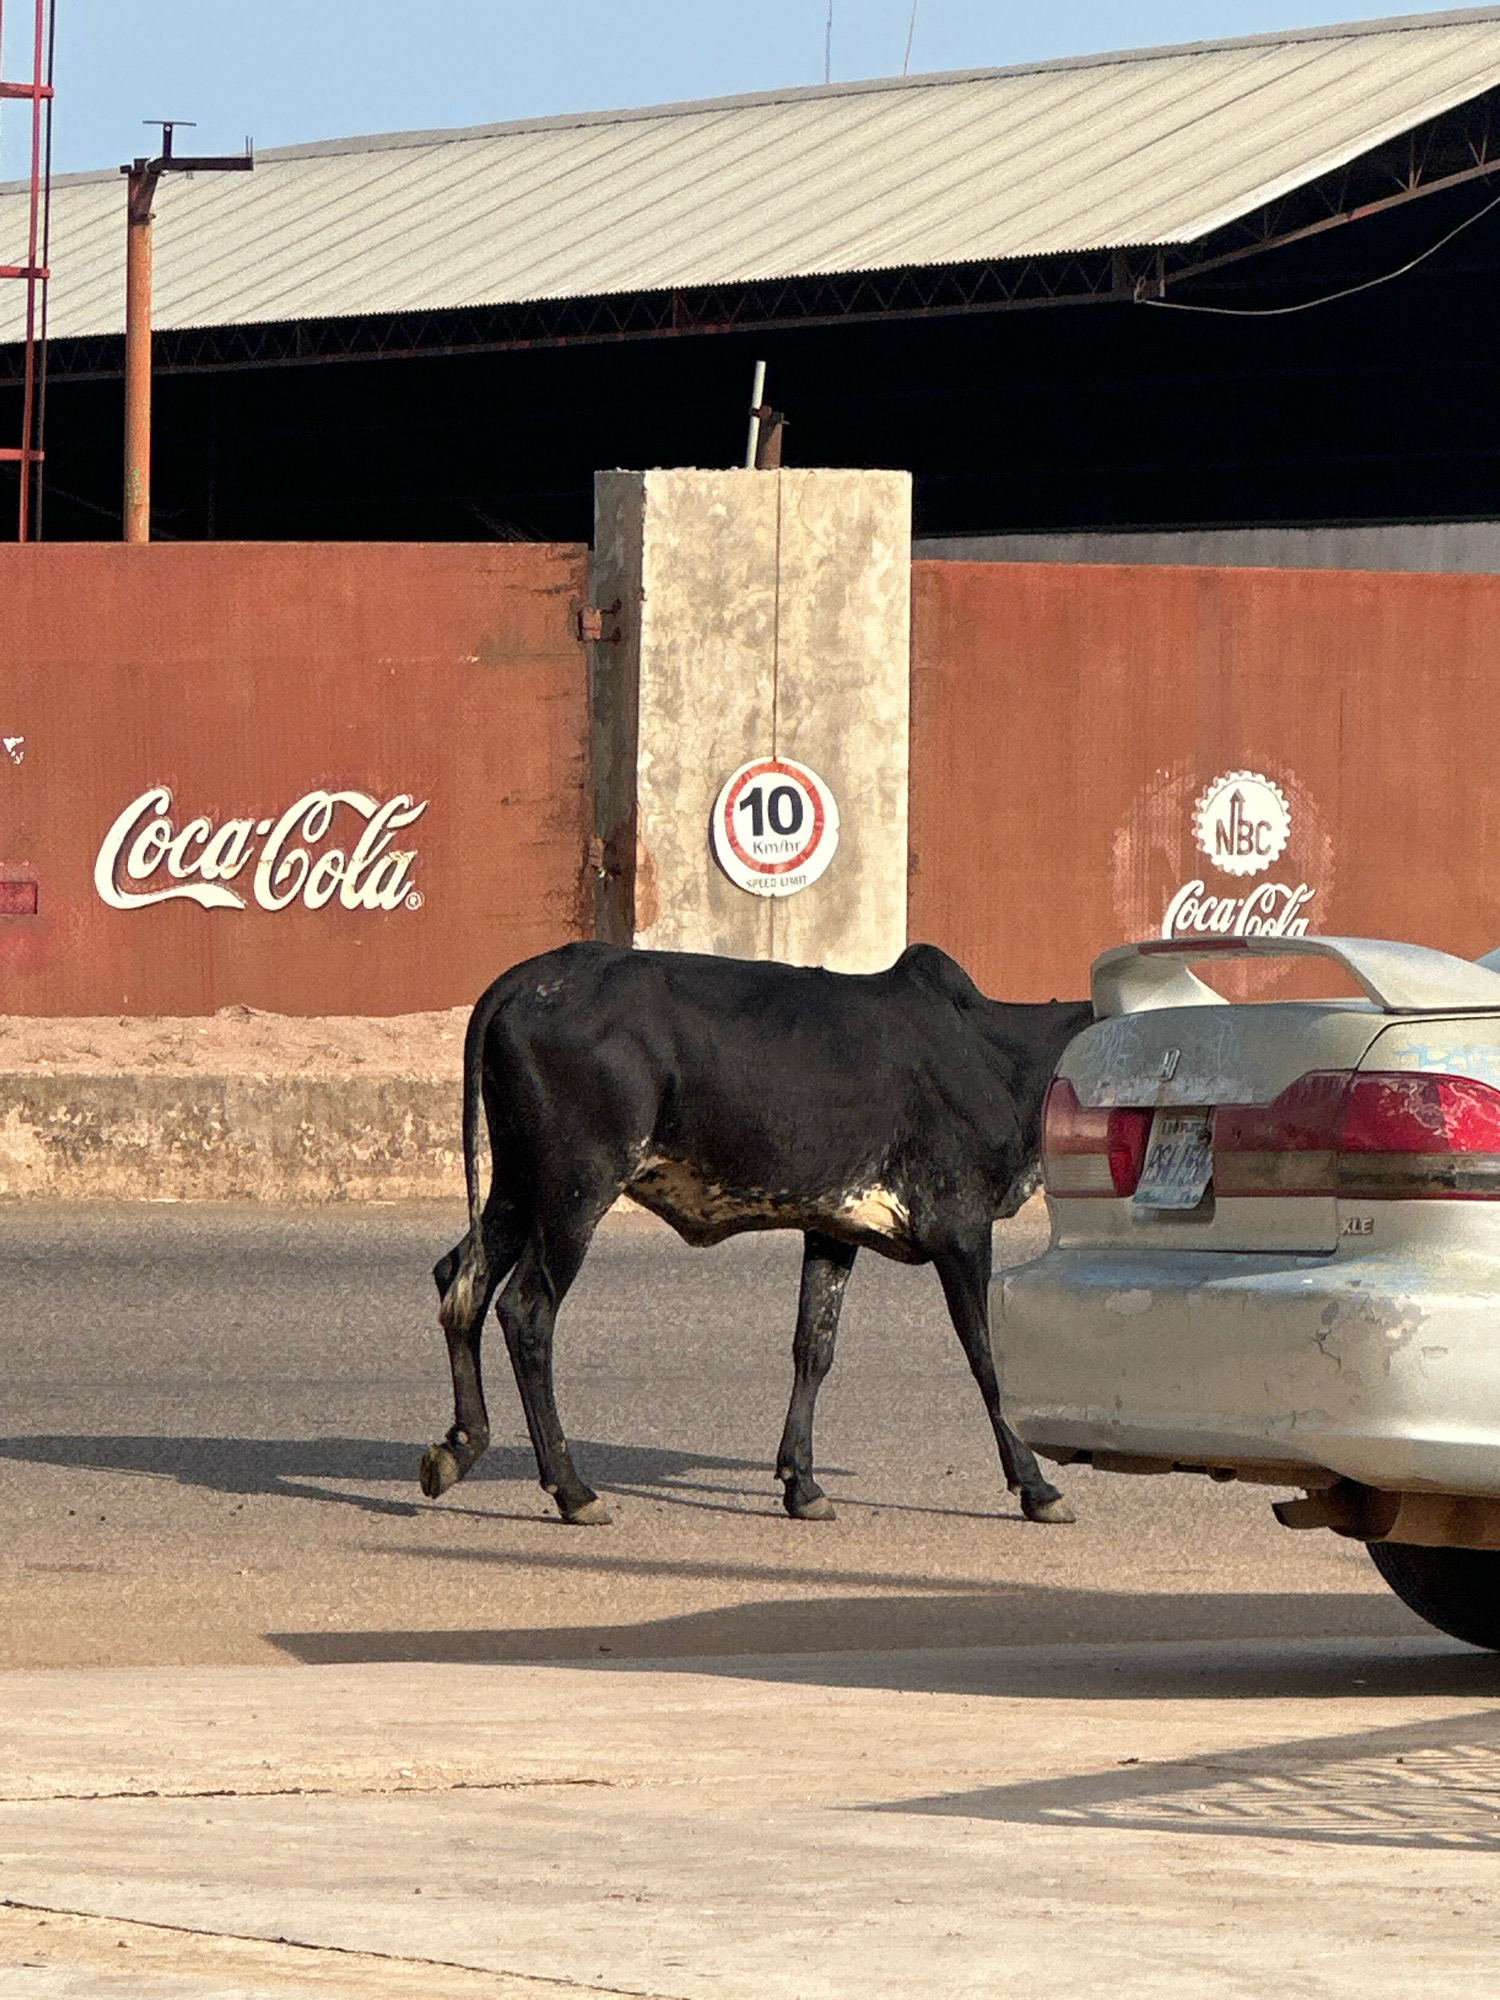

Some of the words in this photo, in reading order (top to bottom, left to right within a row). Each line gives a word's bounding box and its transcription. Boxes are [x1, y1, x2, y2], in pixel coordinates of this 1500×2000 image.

[739, 785, 804, 836] 10
[1215, 800, 1272, 856] NBC
[752, 839, 801, 855] Km/hr
[746, 878, 777, 889] SPEED
[780, 875, 808, 888] LIMIT
[1341, 1217, 1375, 1236] XLE
